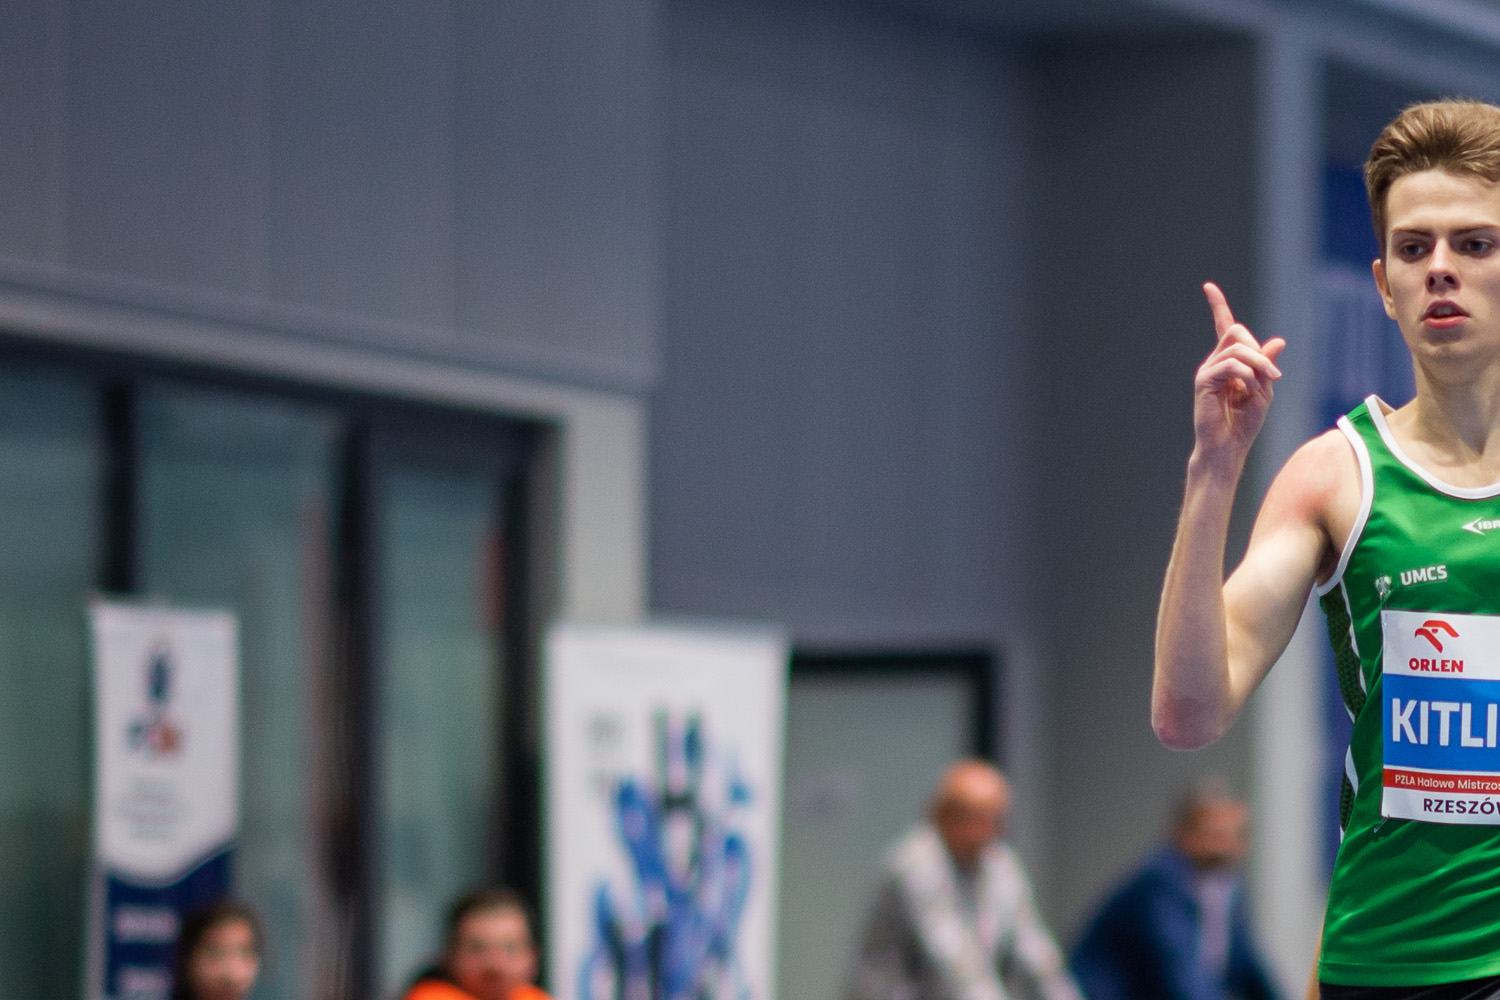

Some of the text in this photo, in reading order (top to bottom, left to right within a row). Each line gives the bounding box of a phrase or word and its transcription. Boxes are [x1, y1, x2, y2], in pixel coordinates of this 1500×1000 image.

[1400, 565, 1448, 587] UMCS
[1408, 657, 1463, 673] ORLEN
[1394, 774, 1416, 786] PZLA
[1417, 777, 1455, 789] Halowe
